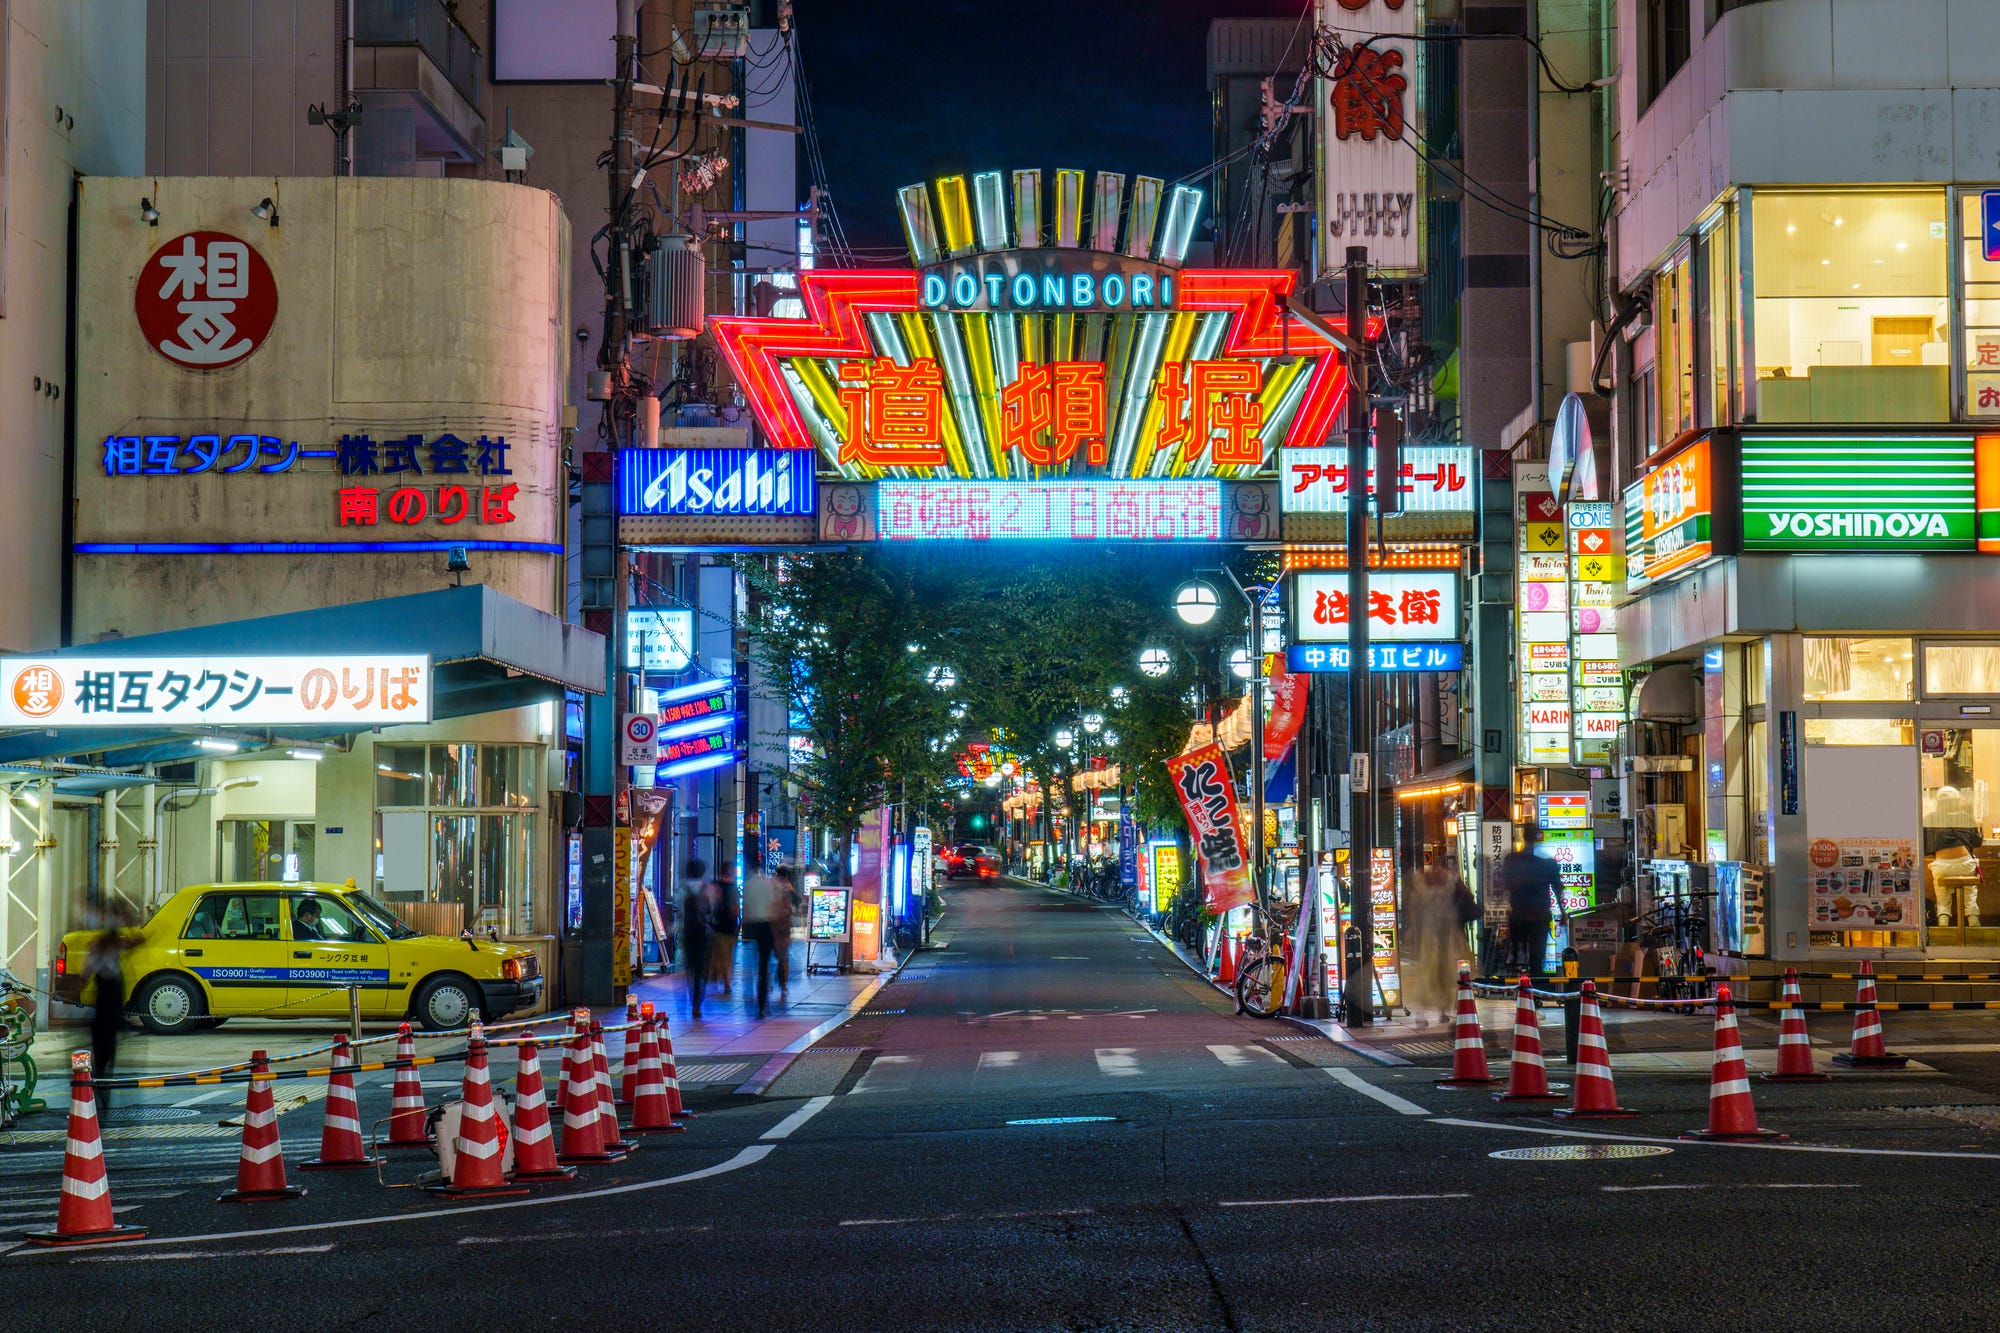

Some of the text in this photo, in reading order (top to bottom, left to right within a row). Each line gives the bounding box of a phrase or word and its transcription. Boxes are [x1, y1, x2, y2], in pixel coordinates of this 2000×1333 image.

[923, 273, 1173, 308] DOTONBORI
[838, 357, 1264, 467] 道頓堀
[643, 452, 792, 510] Asahi
[339, 482, 520, 527] 南のりば
[879, 484, 1218, 539] 道頓堀2丁目商店街
[1570, 512, 1611, 527] OONIS
[1575, 503, 1611, 512] RIVERSID
[1654, 525, 1685, 559] YOSHINOYA
[1769, 512, 1950, 538] YOSHINOYA
[633, 723, 648, 736] 30
[627, 753, 653, 761] ここから
